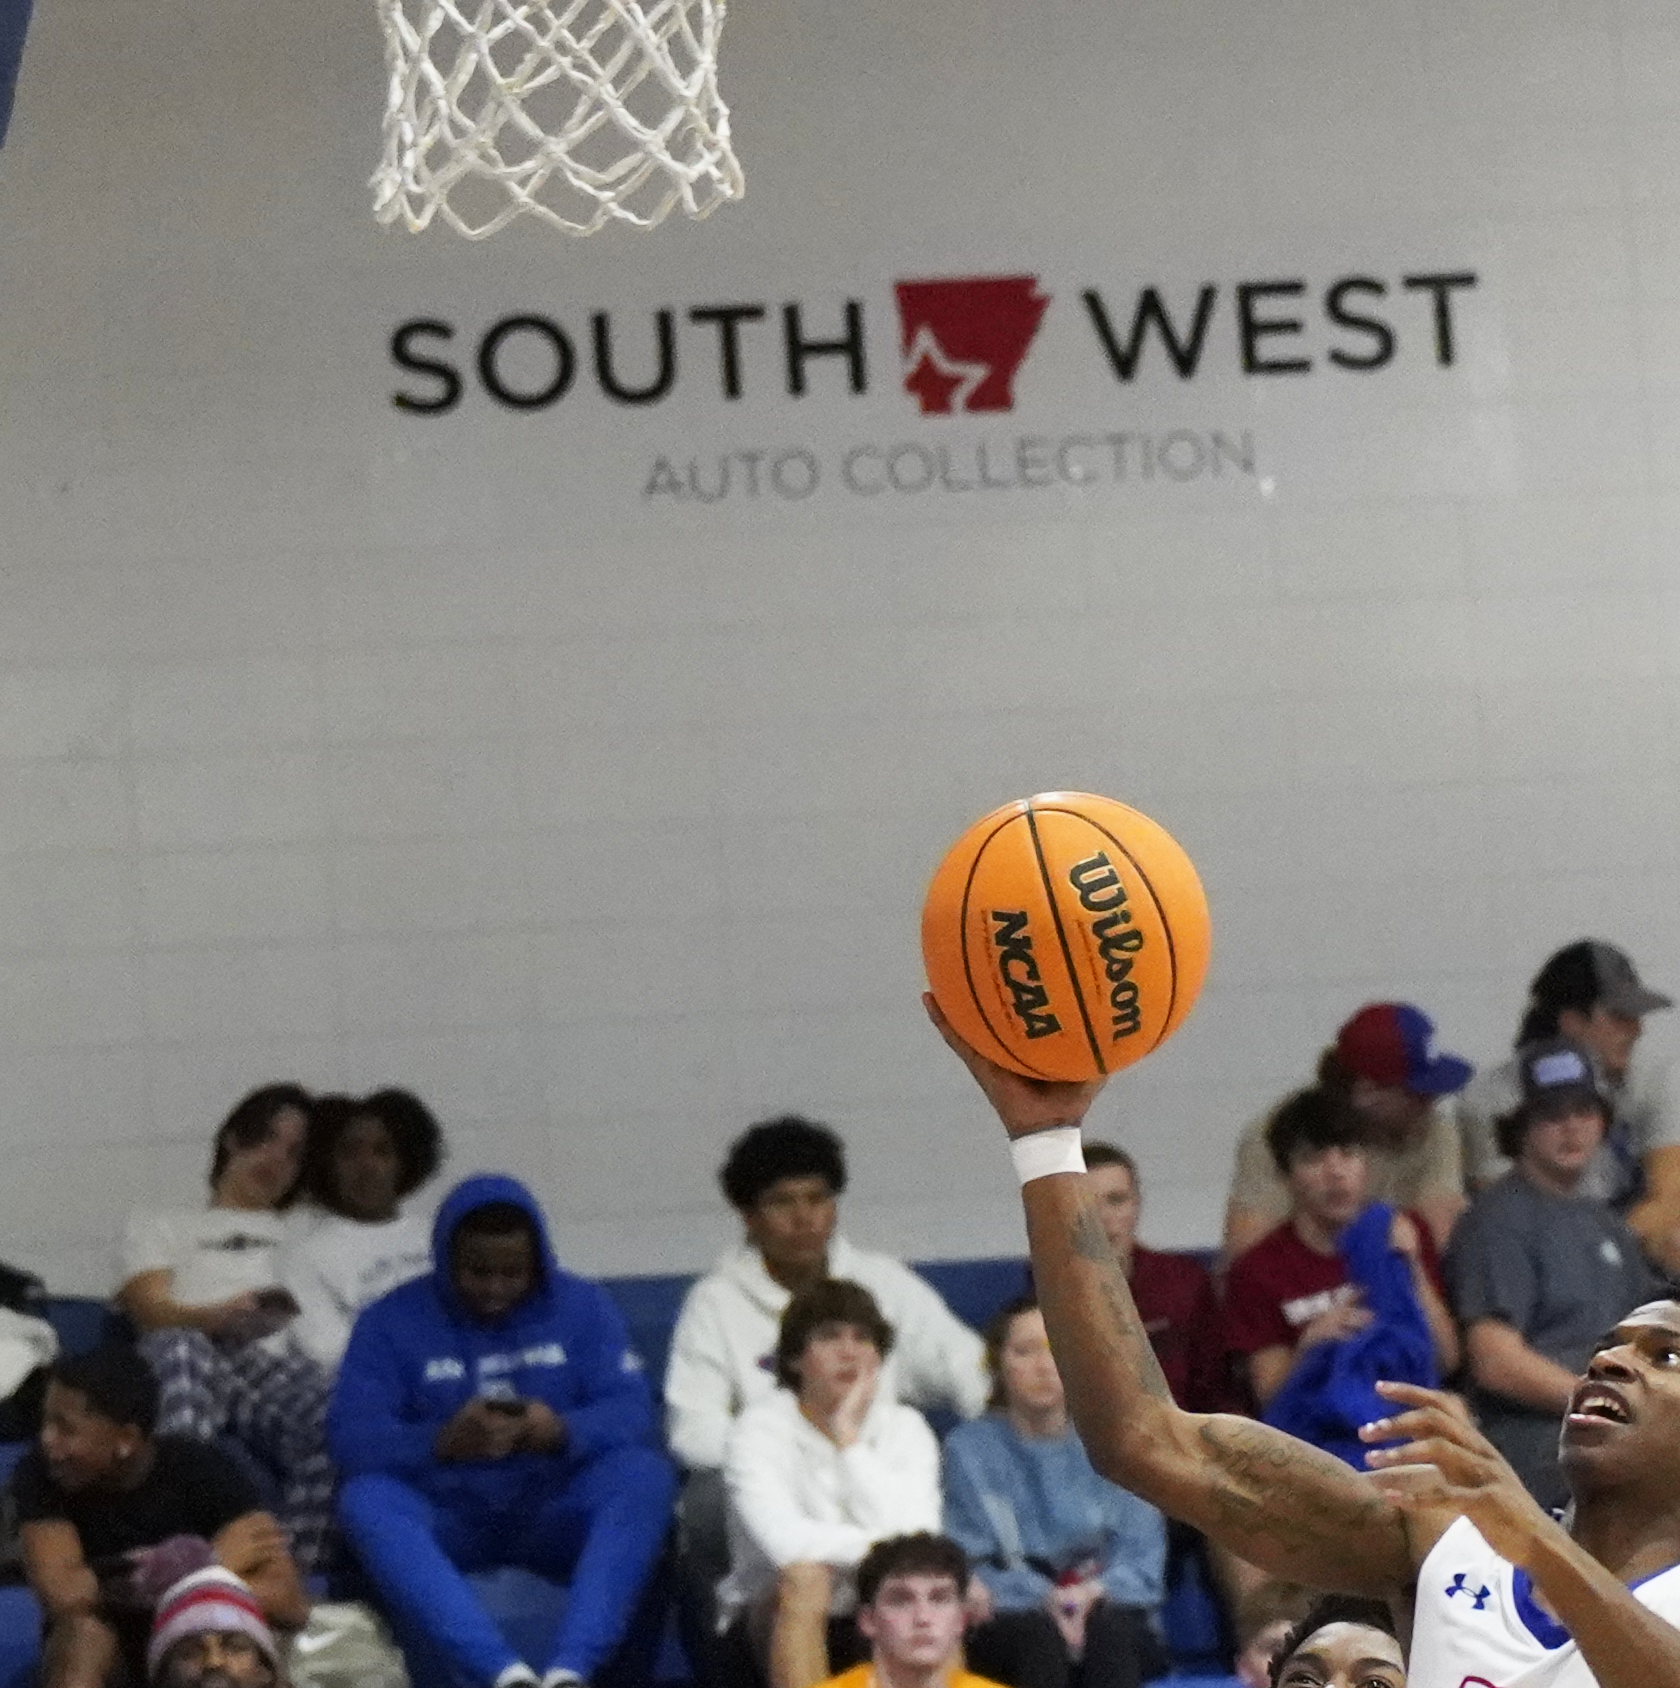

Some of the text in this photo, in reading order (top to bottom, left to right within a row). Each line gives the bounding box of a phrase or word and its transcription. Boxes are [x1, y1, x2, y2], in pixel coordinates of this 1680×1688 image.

[390, 272, 1479, 417] SOUTH WEST
[643, 428, 1256, 503] AUTO COLLECTION
[990, 909, 1063, 1041] NCAA
[1068, 850, 1144, 1045] Wilson
